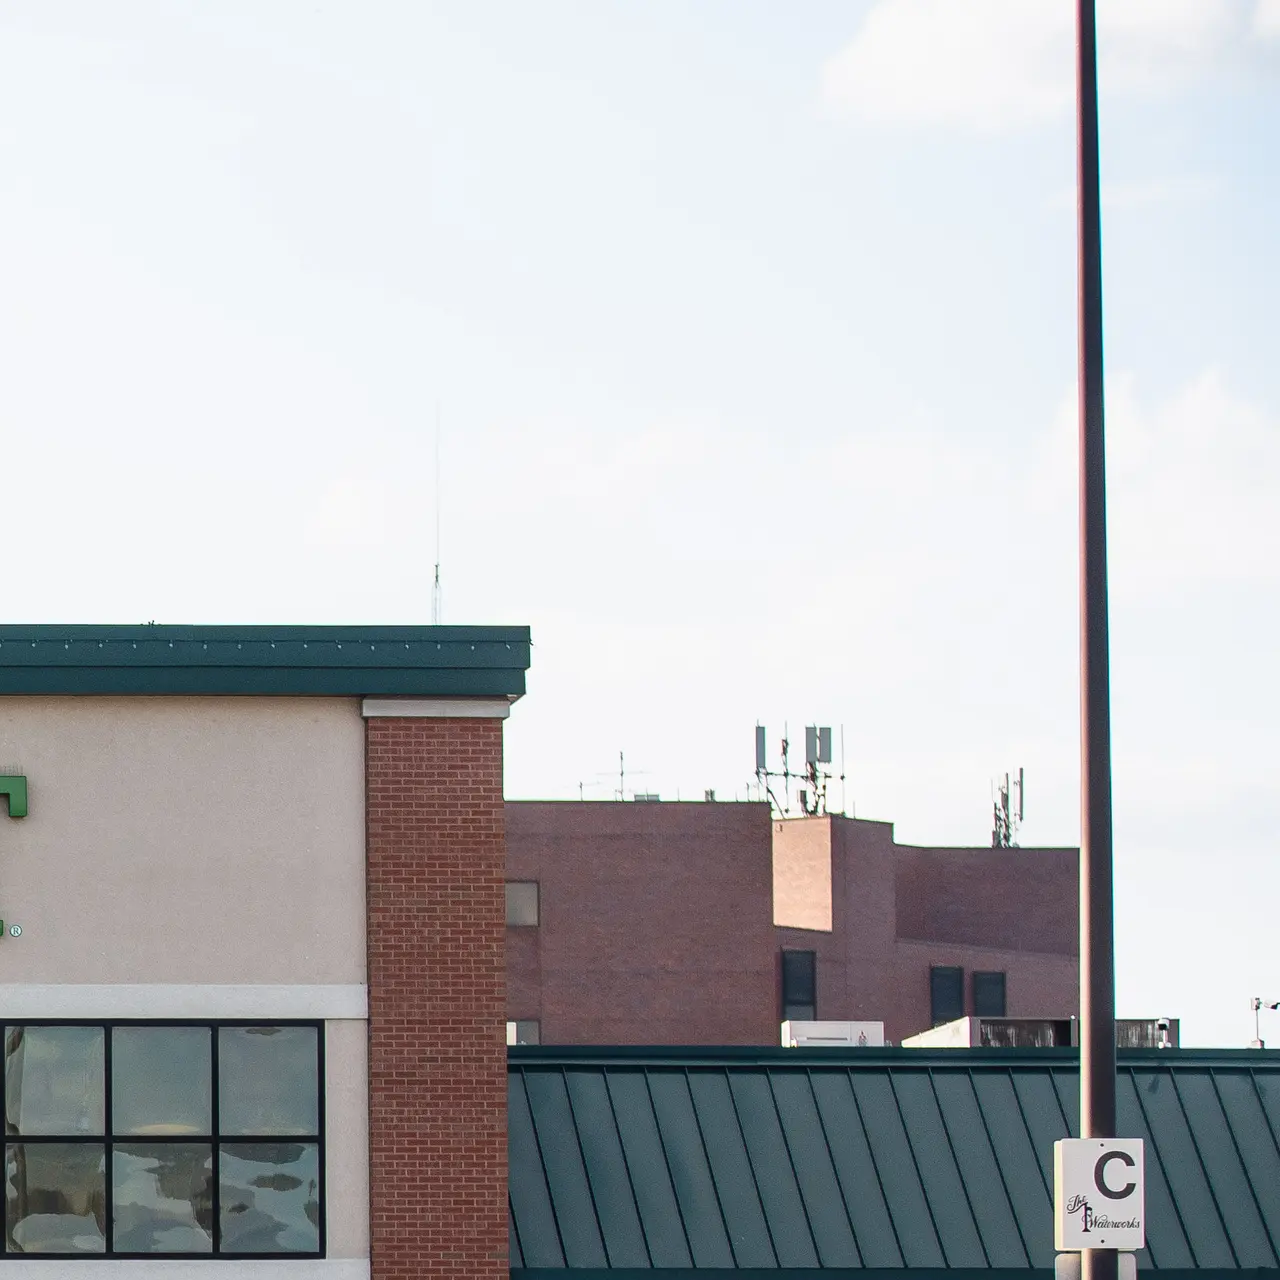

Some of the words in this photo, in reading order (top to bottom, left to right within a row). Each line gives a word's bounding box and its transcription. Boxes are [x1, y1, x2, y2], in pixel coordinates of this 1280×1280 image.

[1093, 1150, 1137, 1200] C
[1066, 1194, 1088, 1213] The
[1082, 1214, 1140, 1230] Waterworks
